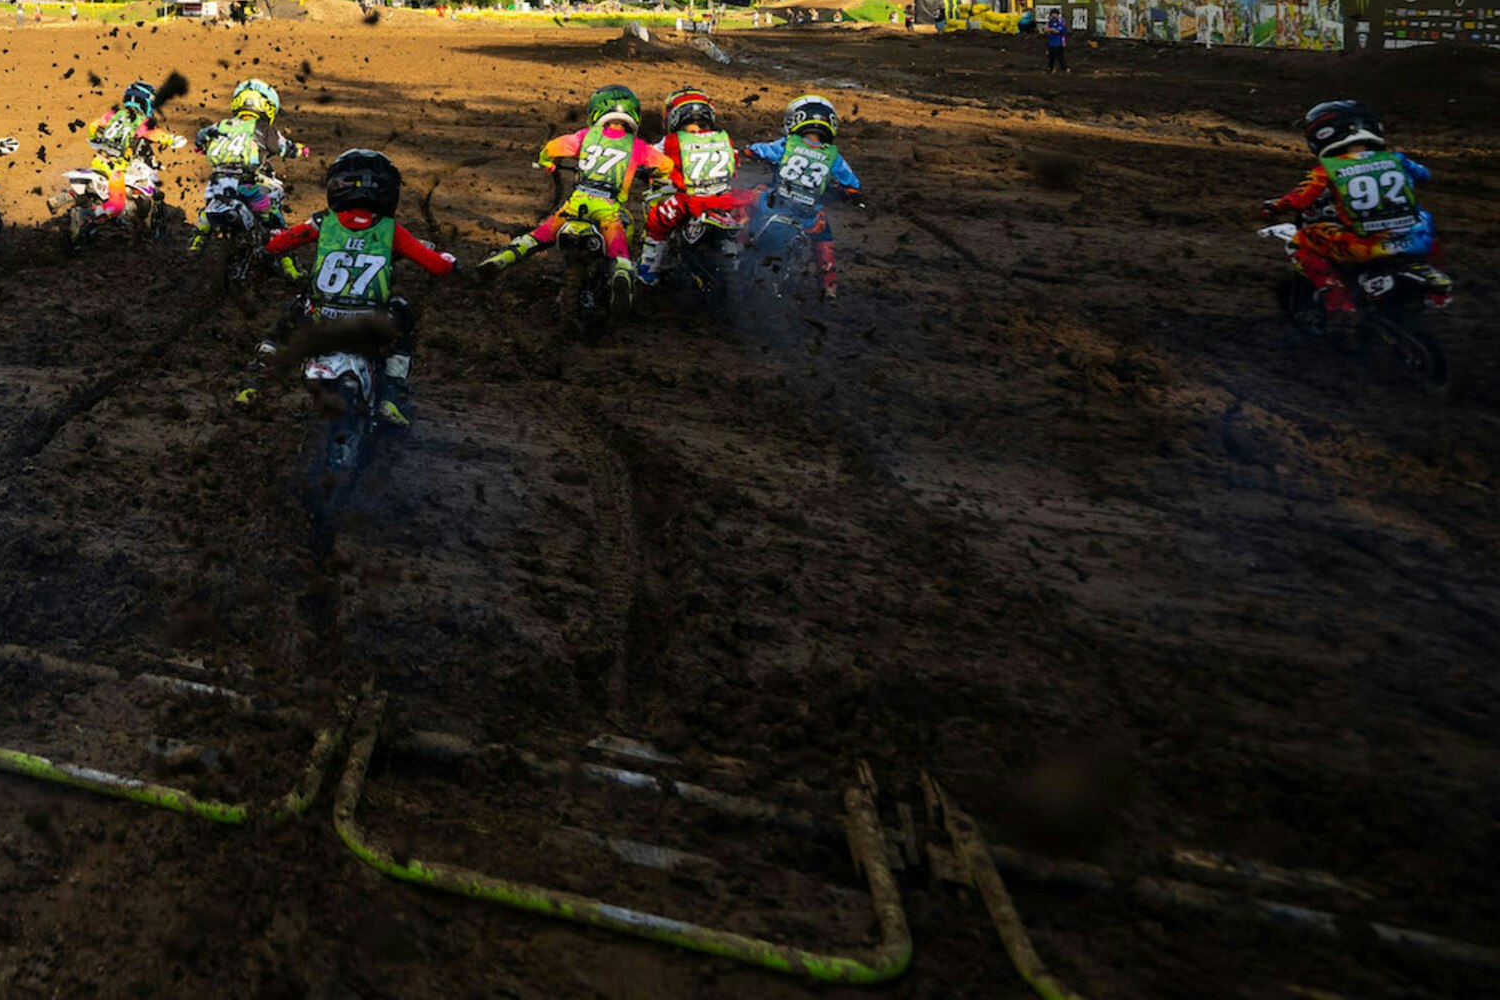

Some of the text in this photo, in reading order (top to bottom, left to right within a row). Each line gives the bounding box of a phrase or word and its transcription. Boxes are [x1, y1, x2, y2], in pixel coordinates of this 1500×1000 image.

[578, 145, 627, 174] 37
[690, 150, 729, 180] 72
[779, 155, 829, 188] 83
[1347, 171, 1407, 210] 92
[345, 237, 366, 250] LEE
[316, 251, 386, 296] 67
